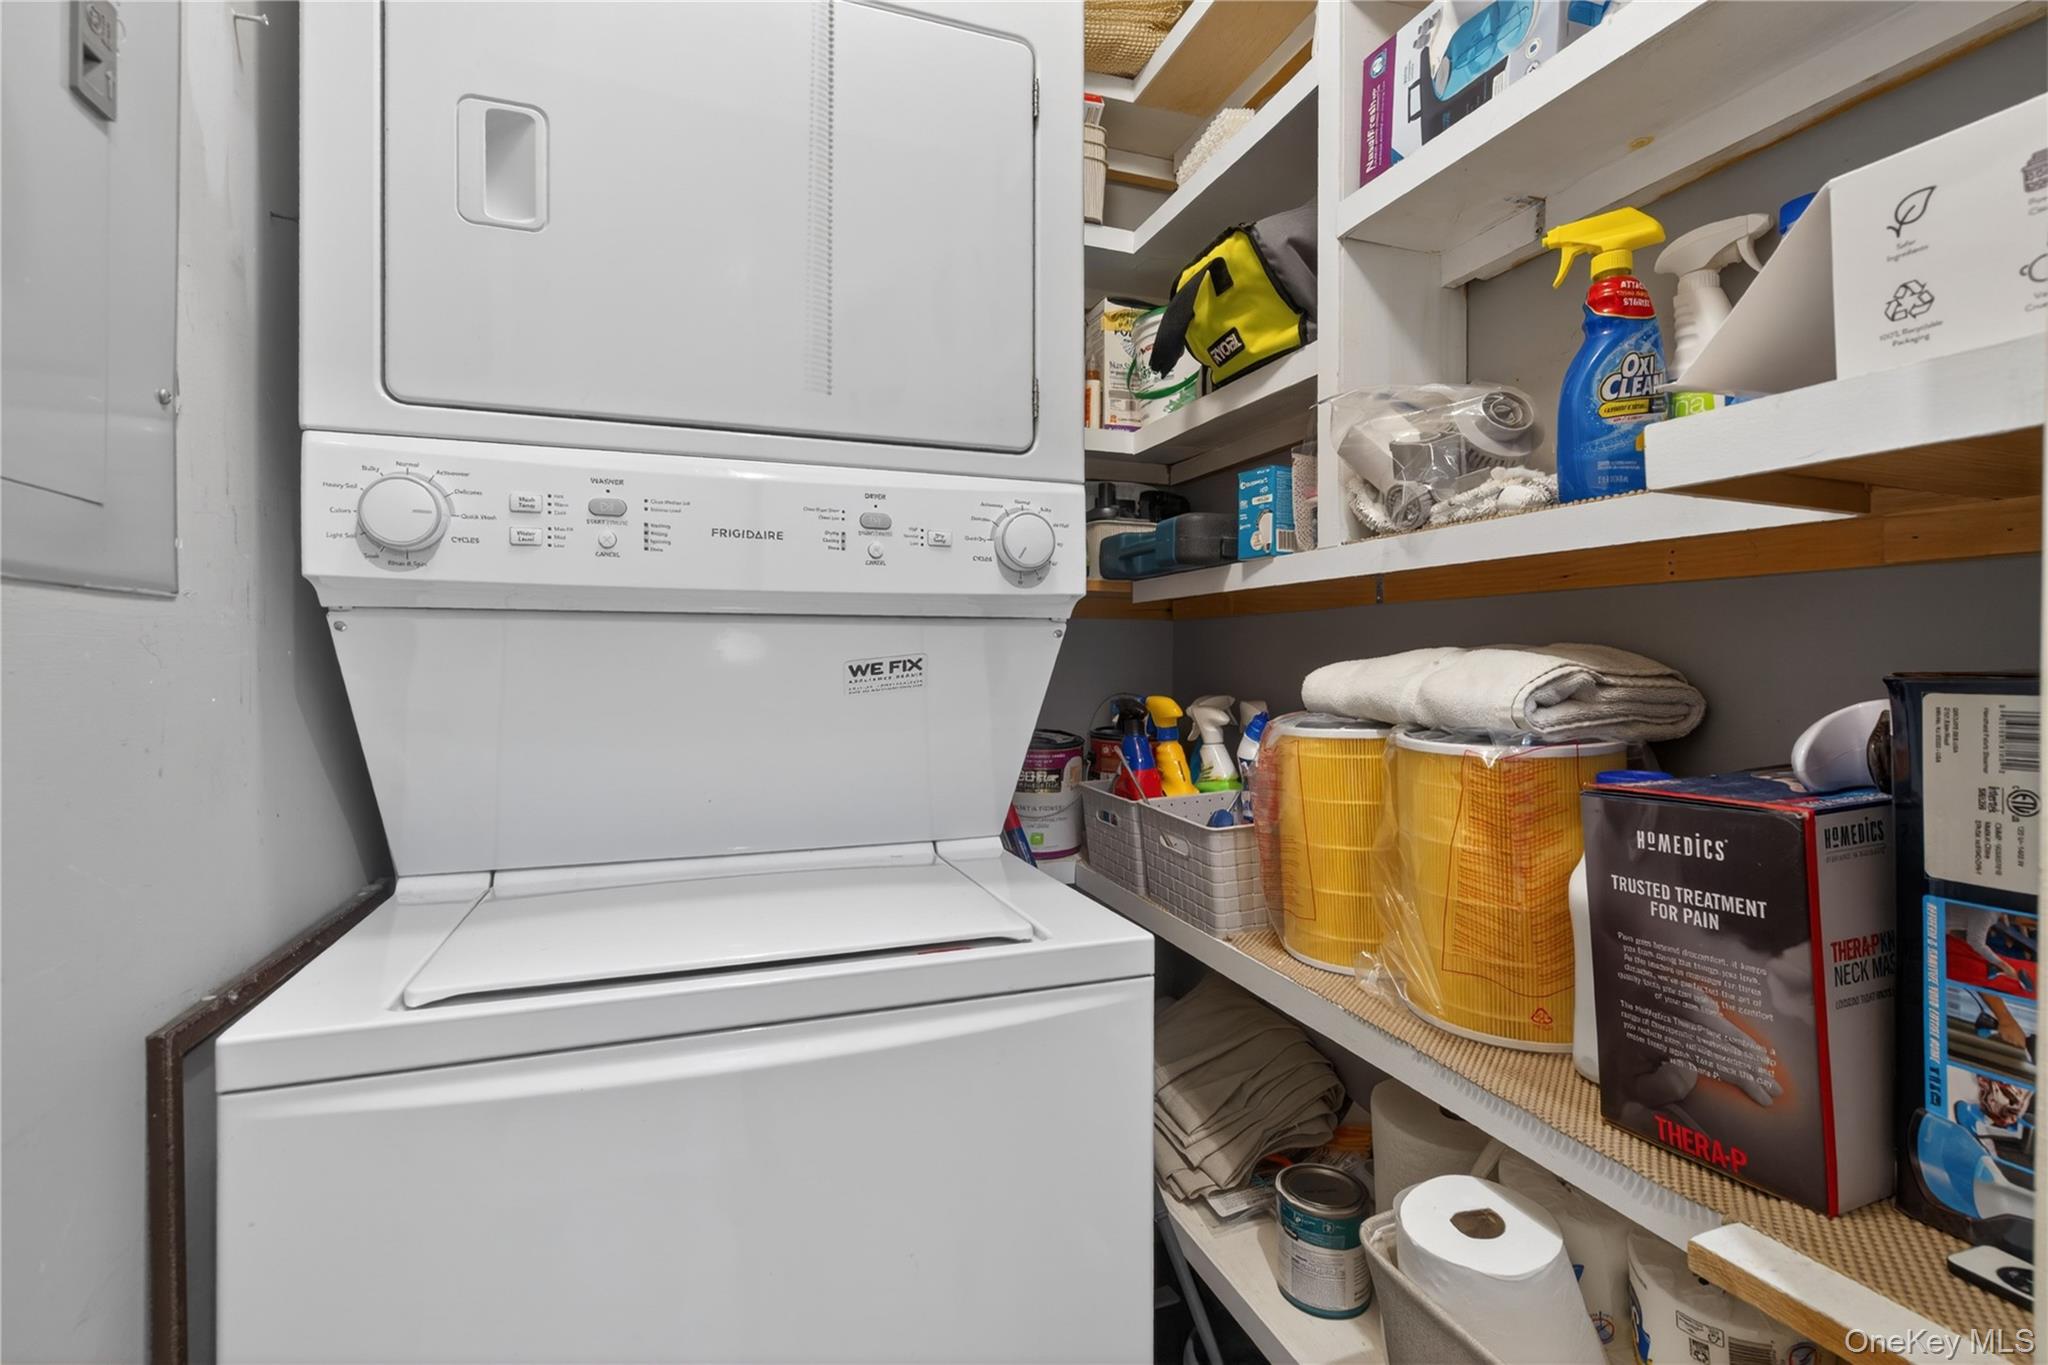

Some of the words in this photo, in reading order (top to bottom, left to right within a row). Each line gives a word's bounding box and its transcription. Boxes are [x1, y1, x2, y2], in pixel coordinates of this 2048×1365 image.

[1210, 333, 1242, 364] RYOBI
[1622, 352, 1655, 378] OXI
[1600, 372, 1664, 401] CLEAN
[322, 481, 343, 490] Heavy
[590, 477, 624, 486] WASHER
[330, 506, 352, 514] Colors
[326, 532, 344, 540] Light
[451, 536, 480, 544] CYCLES
[712, 528, 784, 541] FRIGIDAIRE
[848, 662, 884, 678] WE
[889, 658, 922, 674] FIX
[1988, 786, 2000, 813] Intertek
[1611, 874, 1671, 900] TRUSTED
[1674, 886, 1768, 919] TREATMENT
[1650, 900, 1678, 922] FOR
[1683, 908, 1719, 931] PAIN
[1834, 960, 1869, 988] NECK
[1654, 1114, 1748, 1174] THERA-P
